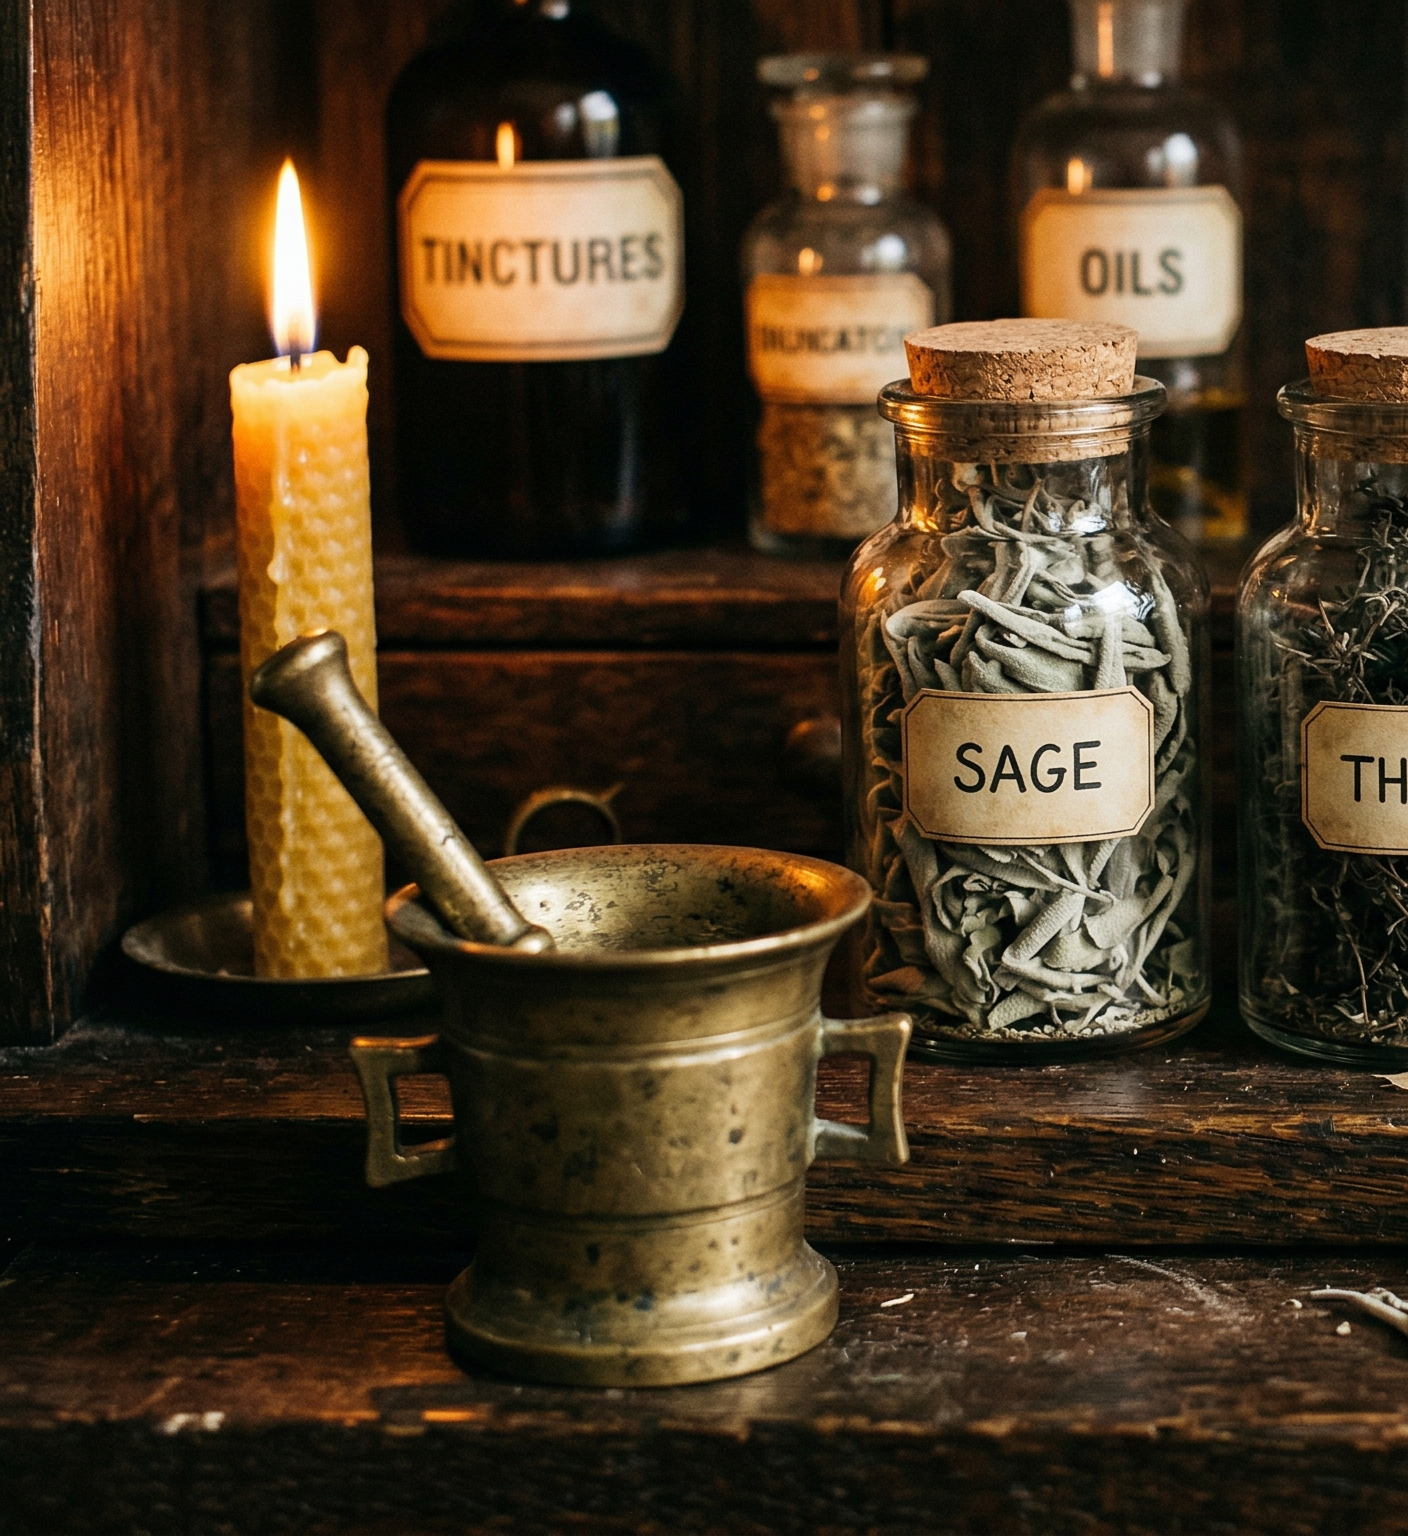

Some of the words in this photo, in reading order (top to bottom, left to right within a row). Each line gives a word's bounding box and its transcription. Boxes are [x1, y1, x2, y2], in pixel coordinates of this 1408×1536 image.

[421, 233, 665, 288] TINCTURES
[1081, 248, 1184, 296] OILS
[954, 740, 1103, 794] SAGE
